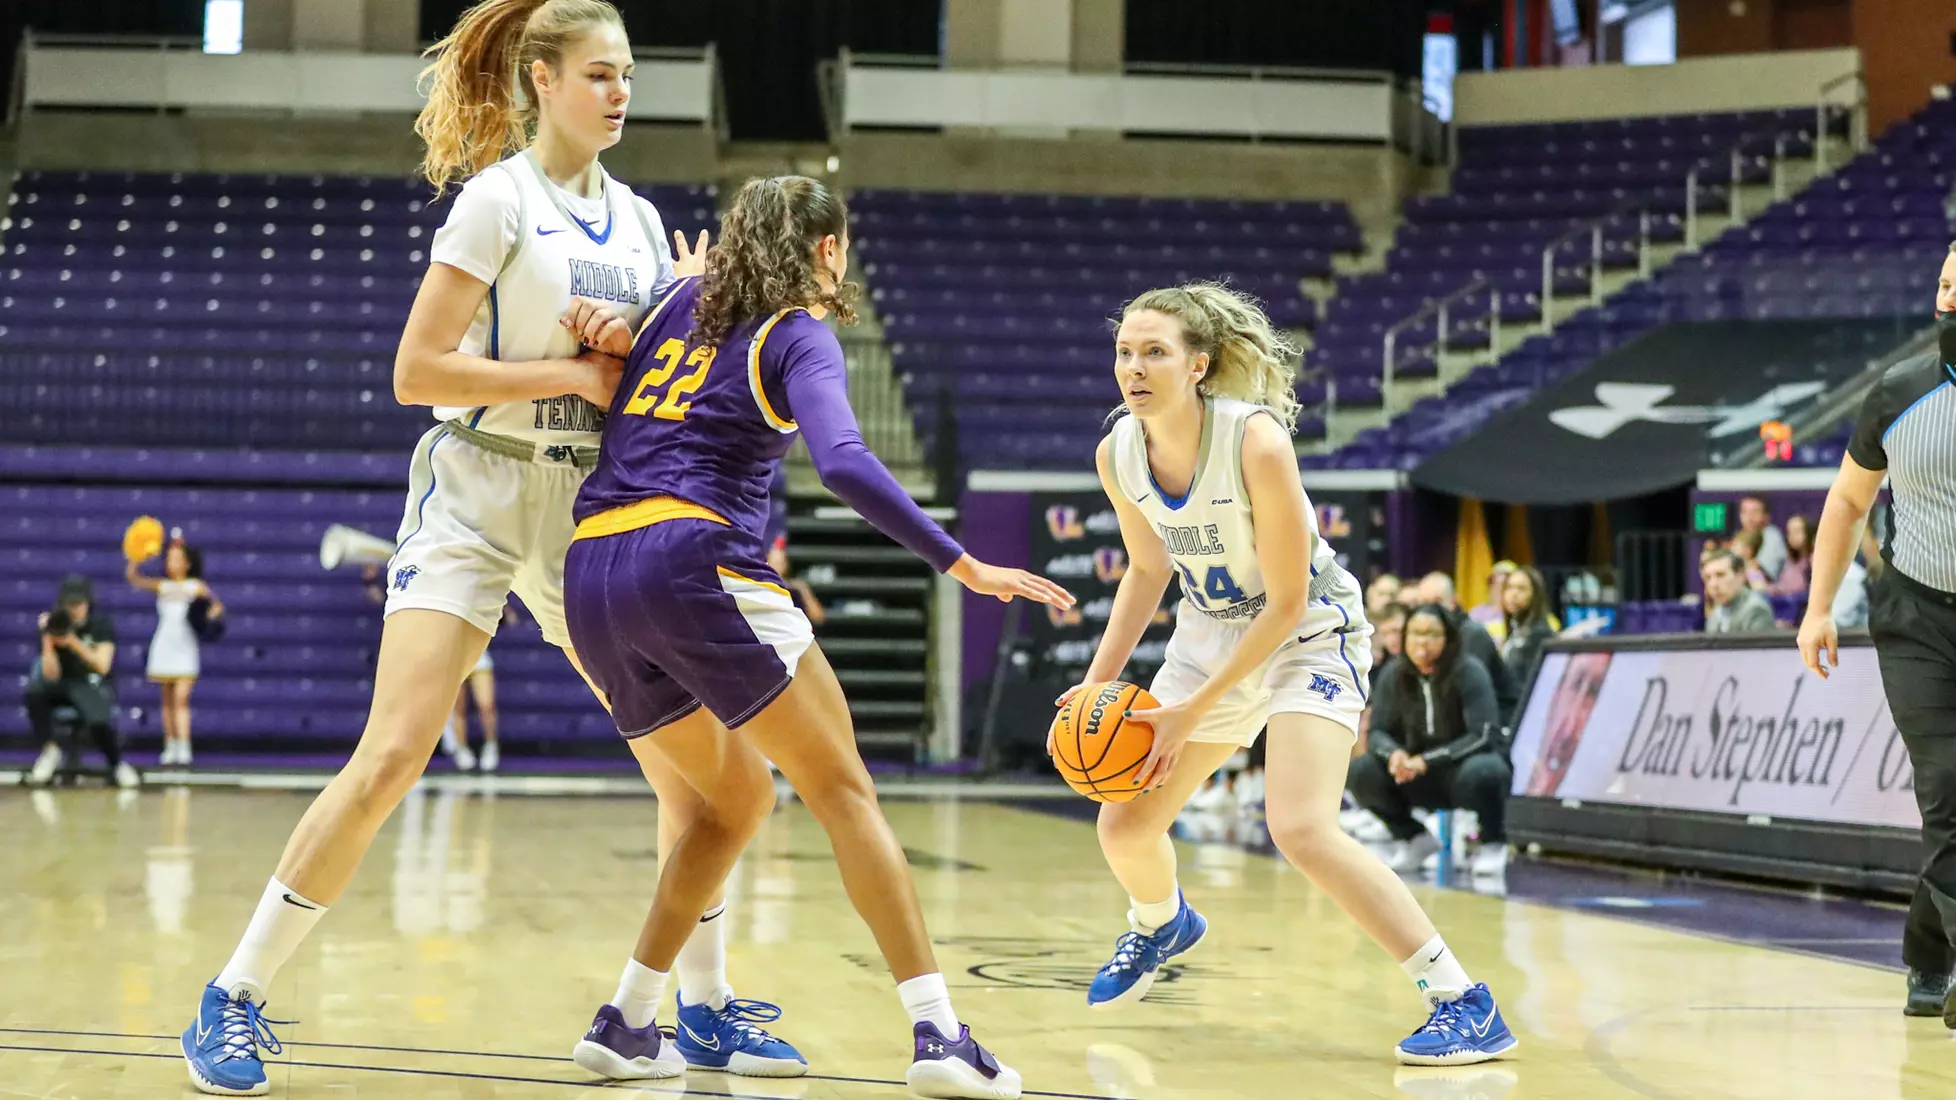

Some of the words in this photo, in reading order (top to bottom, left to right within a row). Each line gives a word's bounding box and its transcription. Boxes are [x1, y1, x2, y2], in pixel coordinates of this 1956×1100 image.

[568, 258, 640, 305] MIDDLE
[623, 337, 717, 421] 22
[1617, 676, 1694, 777] Dan
[1691, 675, 1844, 805] Stephen
